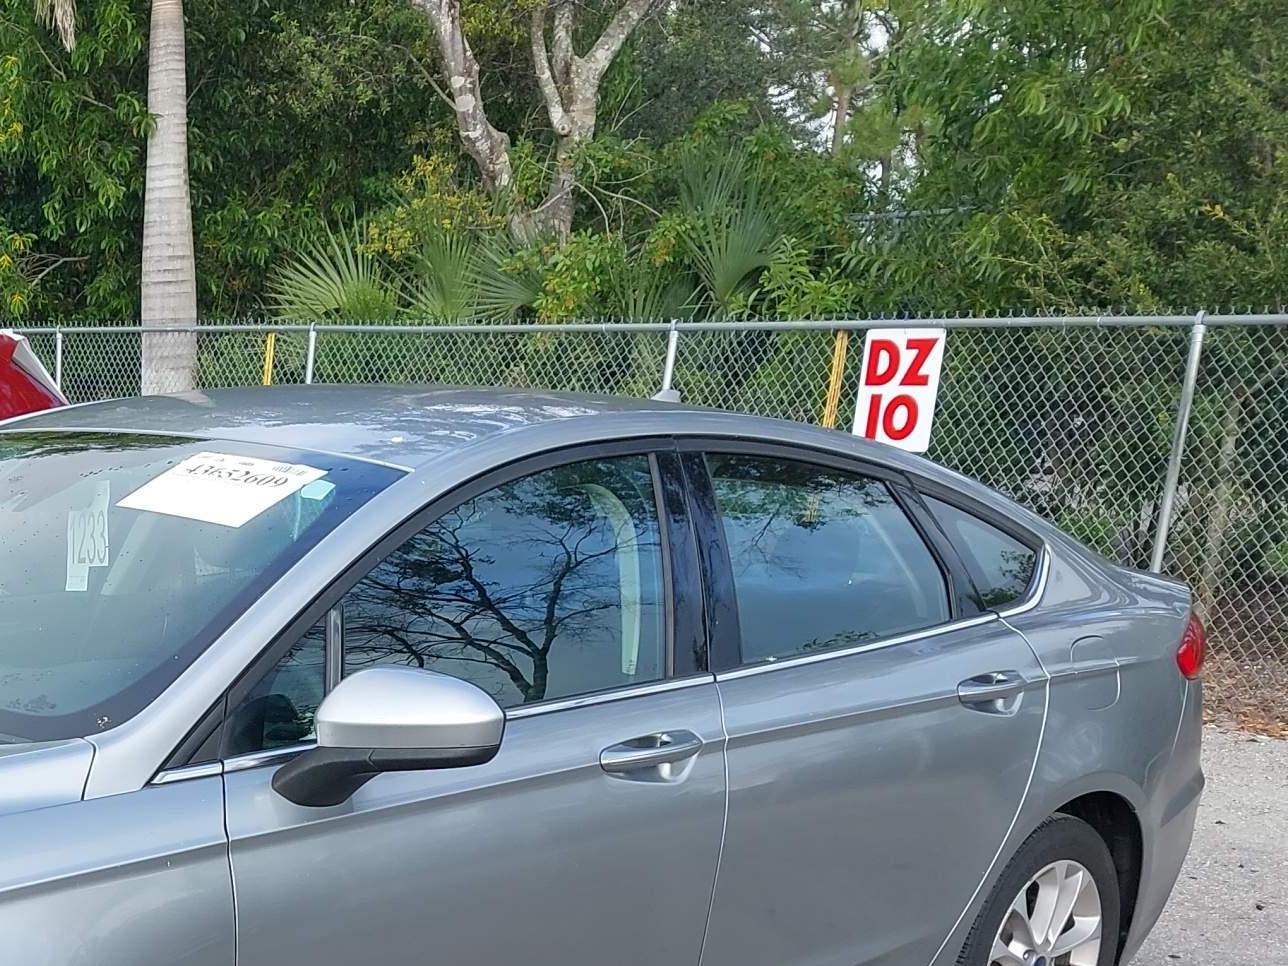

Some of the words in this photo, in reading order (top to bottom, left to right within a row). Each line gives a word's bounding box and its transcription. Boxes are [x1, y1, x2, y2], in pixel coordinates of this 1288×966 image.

[865, 338, 940, 386] DZ
[185, 463, 289, 488] 43652609
[70, 510, 107, 564] 1233
